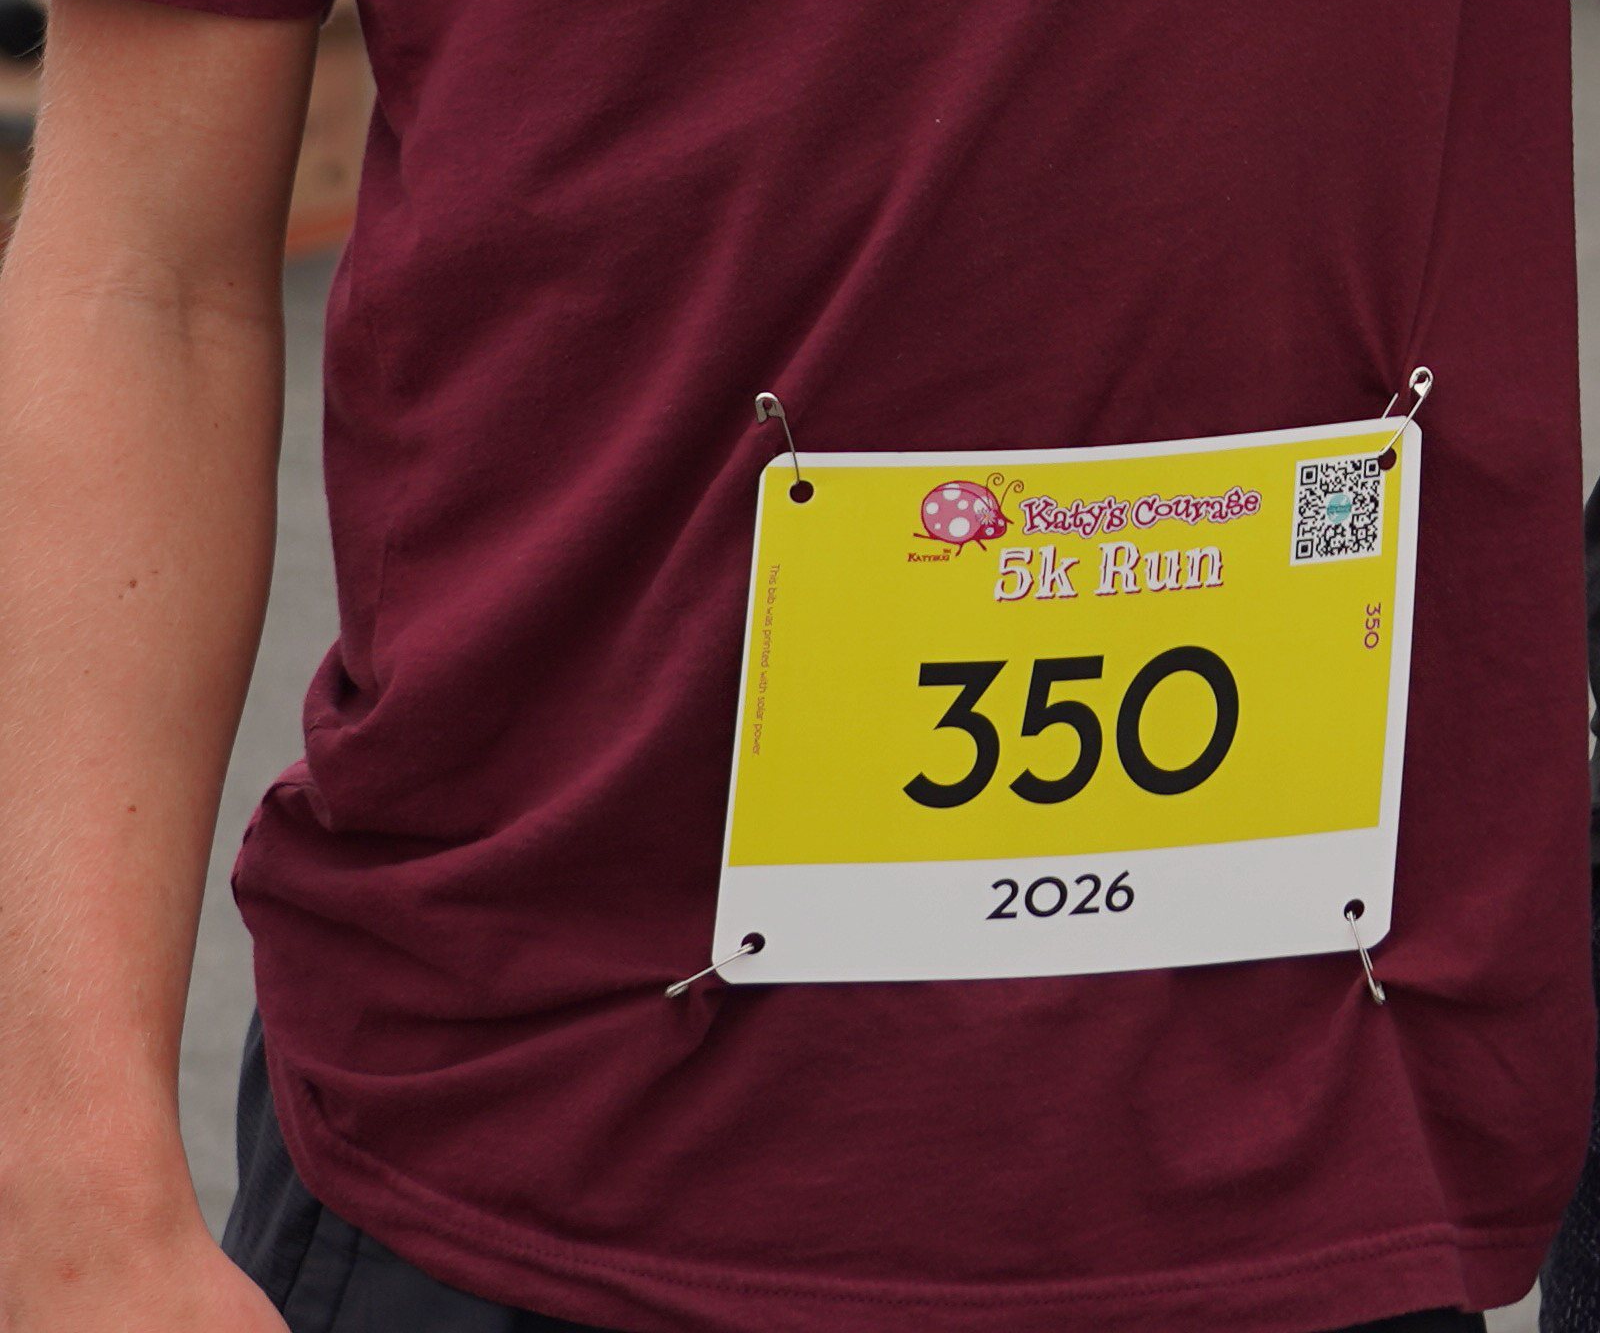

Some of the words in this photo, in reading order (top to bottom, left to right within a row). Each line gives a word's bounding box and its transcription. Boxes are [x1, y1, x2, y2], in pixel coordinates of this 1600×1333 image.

[1020, 495, 1127, 539] Katy's
[1131, 486, 1262, 528] Courage
[768, 564, 781, 585] This
[994, 544, 1080, 602] 5k
[1095, 540, 1224, 596] Run
[1364, 601, 1381, 649] 350
[902, 645, 1239, 809] 350
[986, 870, 1135, 921] 2026
